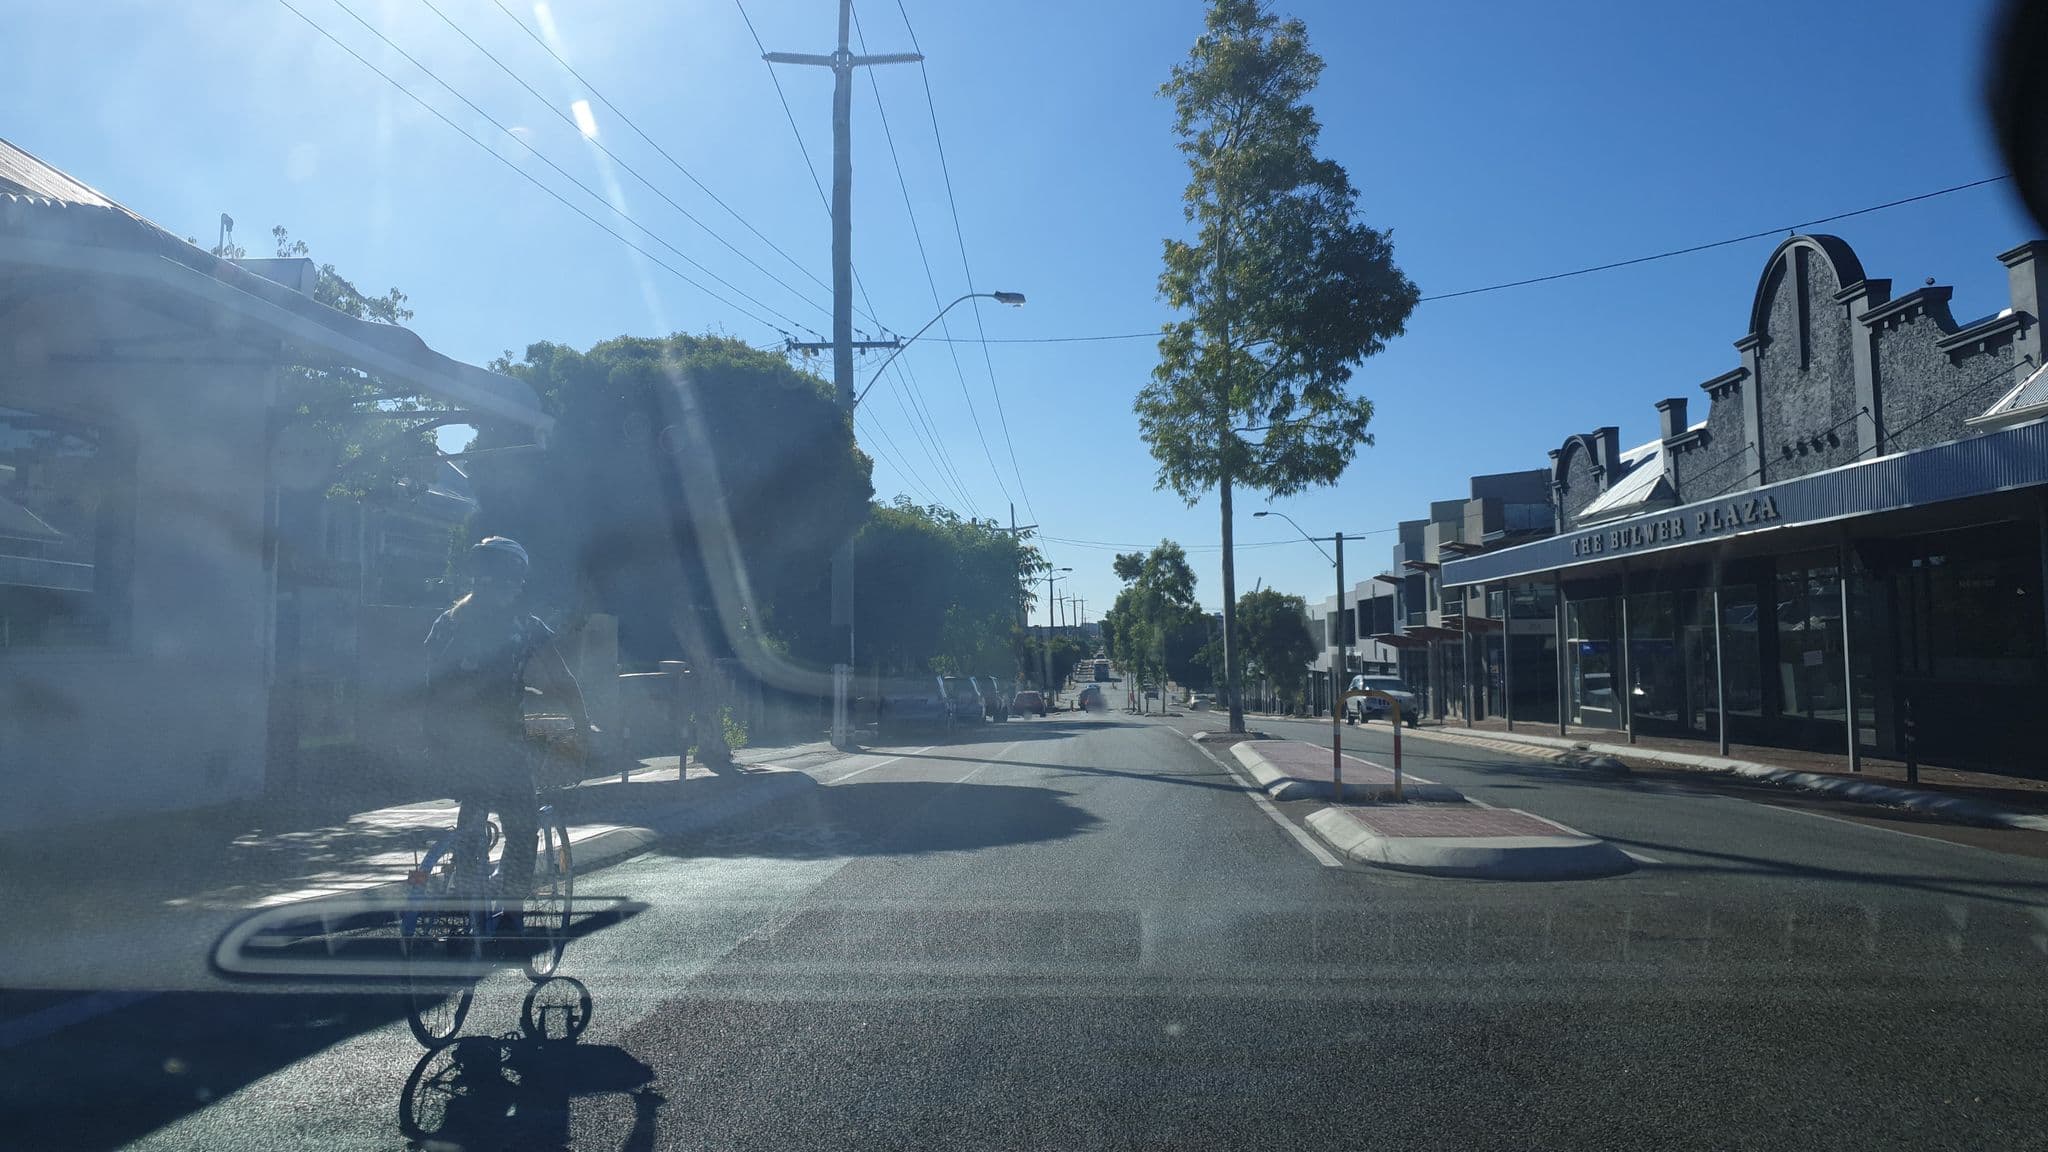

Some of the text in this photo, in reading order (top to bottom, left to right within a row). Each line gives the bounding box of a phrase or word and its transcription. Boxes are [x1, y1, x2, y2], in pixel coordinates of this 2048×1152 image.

[1571, 495, 1780, 556] THE BULWER PLAZA
